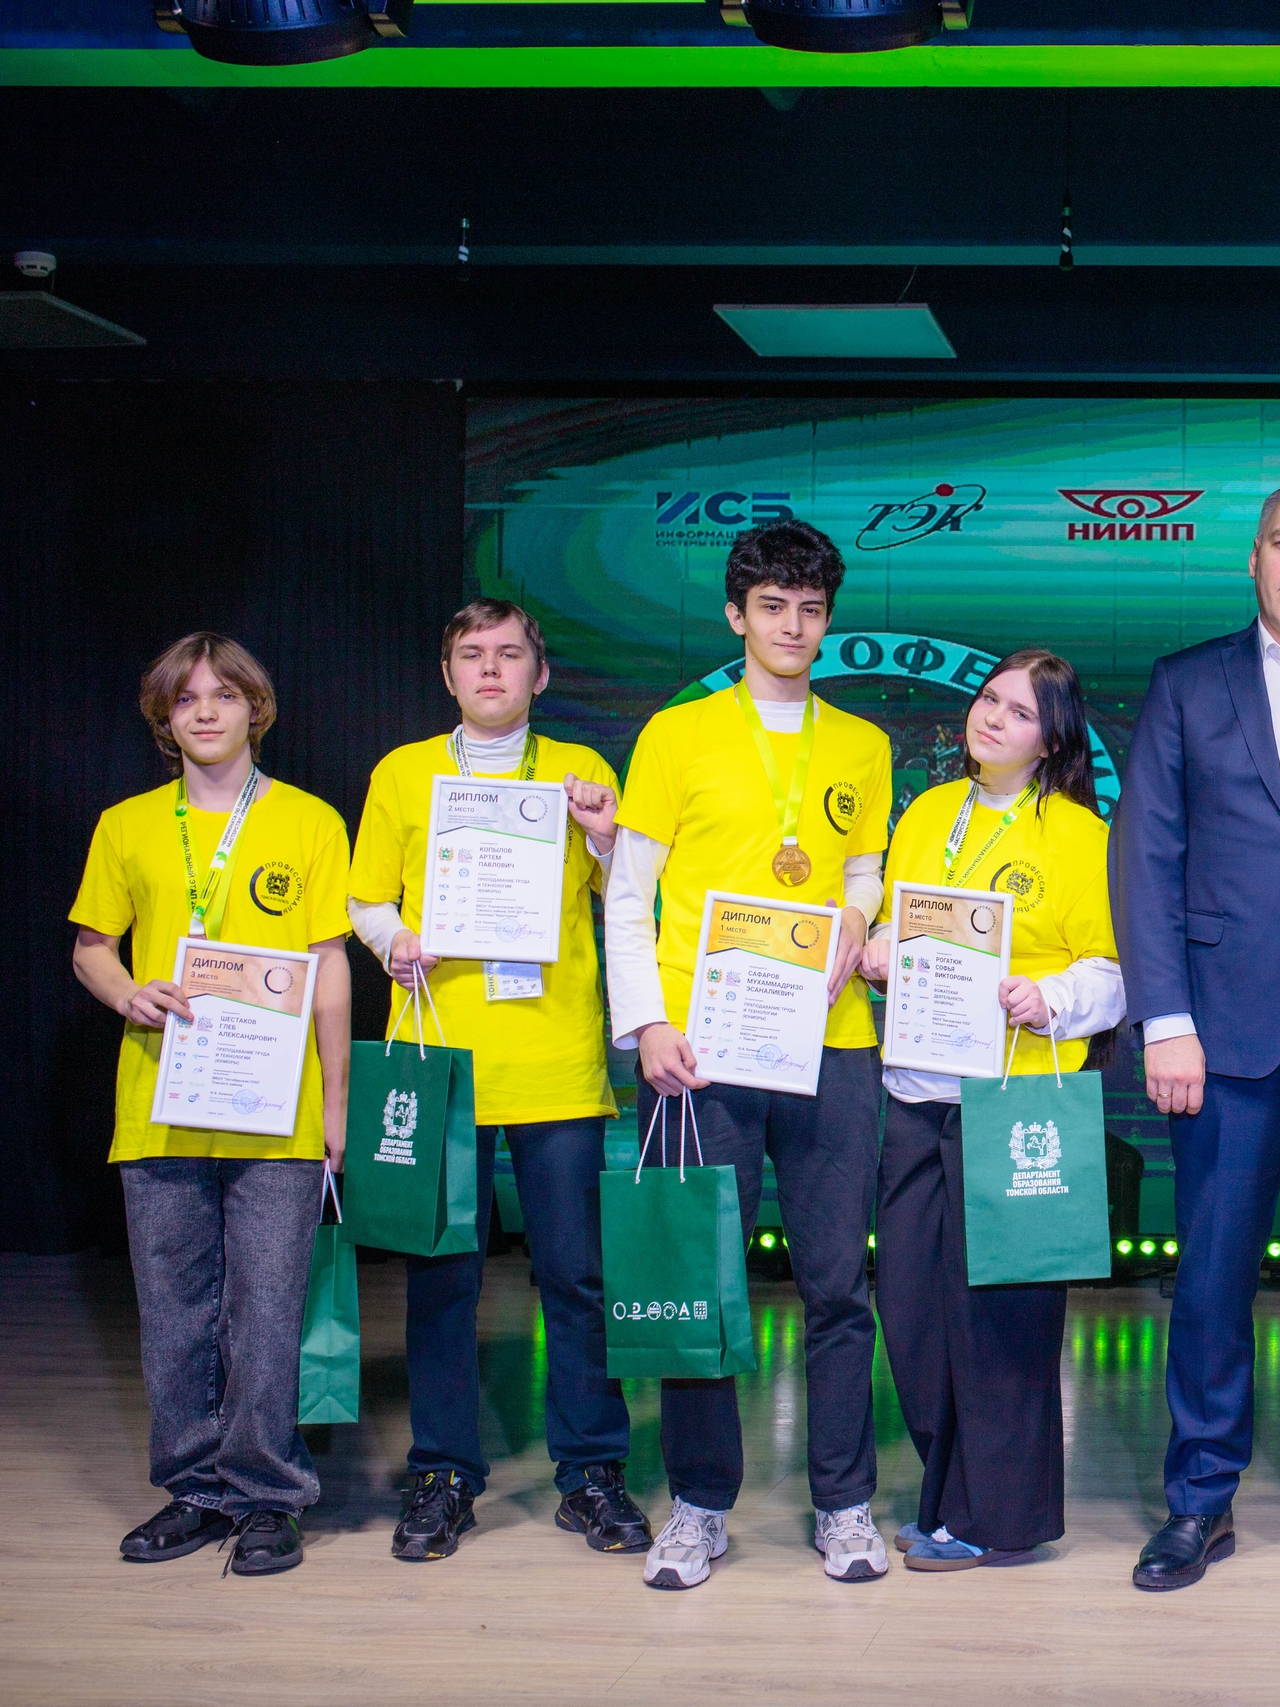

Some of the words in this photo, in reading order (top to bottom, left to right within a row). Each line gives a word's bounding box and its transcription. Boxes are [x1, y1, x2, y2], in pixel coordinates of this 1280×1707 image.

[656, 531, 738, 540] ИНФОРМАЦ
[1068, 522, 1194, 541] НИИПП
[449, 792, 498, 802] ДИПЛОМ
[964, 827, 1004, 879] РЕГИОНАЛЬНЫЙ
[180, 821, 195, 878] РЕГИОНАЛЬНЫЙ
[188, 879, 197, 900] ЭТАП
[264, 861, 303, 916] ПРОФЕССИОНАЛЫ
[910, 899, 953, 912] ДИПЛОМ
[721, 911, 771, 925] ДИПЛОМ
[192, 958, 244, 972] ДИПЛОМ
[936, 956, 962, 965] РОГАТЮК
[935, 964, 955, 972] СОФЬЯ
[748, 971, 779, 980] САФАРОВ
[935, 972, 973, 982] ВИКТОРОВНА
[747, 978, 804, 991] МУХАММАДРИЗО
[746, 986, 794, 997] ЭСАНАЛИЕВИЧ
[933, 994, 964, 1002] ДЕЯТЕЛЬНОСТЬ
[744, 1002, 781, 1011] ПРЕПОДАВАНИЕ
[748, 1008, 777, 1016] ТЕХНОЛОГИИ
[220, 1016, 257, 1025] ШЕСТАКОВ
[218, 1031, 277, 1043] АЛЕКСАНДРОВИЧ
[216, 1047, 253, 1056] ПРЕПОДАВАНИЕ
[1013, 1170, 1060, 1181] ДЕПАРТАМЕНТ
[1013, 1178, 1061, 1188] ОБРАЗОВАНИЯ
[1006, 1187, 1037, 1197] ТОМСКОЙ
[1038, 1186, 1069, 1195] ОБЛАСТИ
